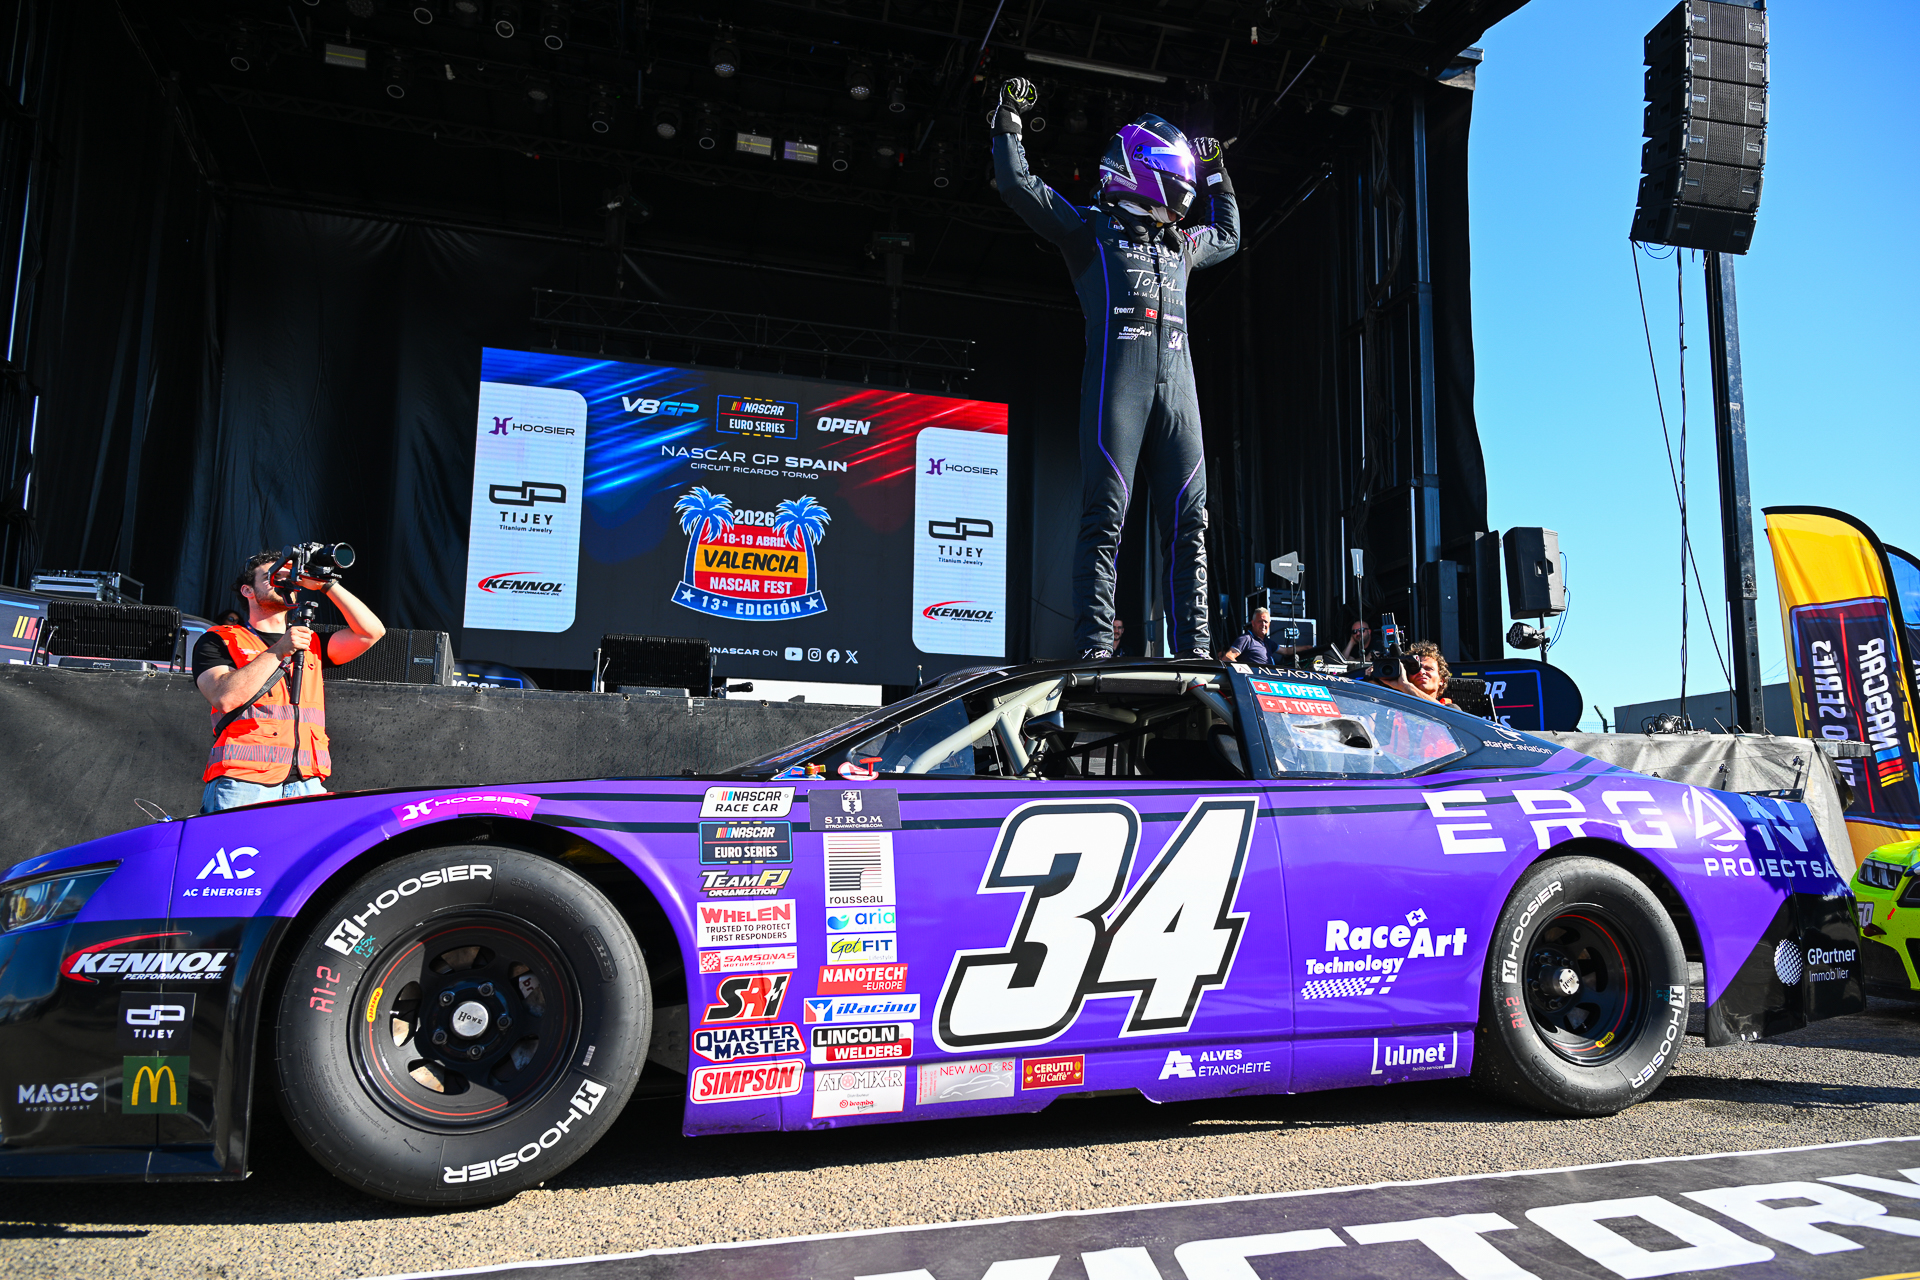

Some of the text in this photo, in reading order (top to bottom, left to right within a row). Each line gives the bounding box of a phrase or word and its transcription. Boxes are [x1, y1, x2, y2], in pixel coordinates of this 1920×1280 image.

[1168, 331, 1182, 350] 34
[622, 397, 699, 416] V8GP
[744, 402, 784, 416] NASCAR
[512, 423, 575, 436] HOOSIER
[729, 419, 785, 434] EURO SERIES
[817, 417, 870, 435] OPEN
[662, 445, 847, 472] NASCAR GP SPAIN
[691, 463, 819, 480] CIRCUIT RICARDO TORMO
[945, 464, 998, 475] HOOSIER
[500, 511, 553, 525] TIJEY
[735, 509, 775, 527] 2026
[499, 524, 552, 534] Titanium Jewelry
[722, 533, 786, 547] 18-19 ABRIL
[938, 545, 983, 558] TIJEY
[704, 549, 799, 573] VALENCIA
[483, 579, 563, 593] KENNOL
[709, 577, 792, 595] NASCAR FEST
[736, 600, 801, 616] EDICIÓN
[928, 607, 994, 620] KENNOL
[762, 649, 778, 657] ON
[1272, 682, 1330, 699] T. TOFFEL
[1280, 700, 1338, 716] T. TOFFEL
[1484, 740, 1552, 755] starjet aviation
[435, 795, 530, 808] HOOSIER
[733, 791, 782, 801] NASCAR
[715, 804, 778, 812] RACE CAR
[825, 816, 882, 825] STROM
[731, 827, 775, 839] NASCAR
[714, 845, 778, 858] EURO SERIES
[182, 886, 262, 897] AC ÉNERGIES
[352, 864, 494, 927] HOOSIER
[709, 887, 777, 897] ORGANIZATION
[829, 894, 884, 904] rousseau
[855, 908, 895, 925] aria
[1507, 880, 1563, 960] HOOSIER
[706, 923, 791, 933] TRUSTED TO PROTECT
[937, 799, 1257, 1050] 34
[711, 932, 787, 942] FIRST RESPONDERS
[70, 952, 228, 973] KENNOL
[724, 952, 796, 963] SAMSONAS
[1807, 948, 1856, 966] GPartner
[1305, 955, 1404, 975] Technology
[123, 971, 222, 980] PERFORMANCE OIL
[823, 967, 904, 983] NANOTECH
[836, 1001, 917, 1015] iRacing
[133, 1029, 174, 1039] TIJEY
[696, 1024, 795, 1051] QUARTER
[817, 1027, 895, 1045] LINCOLN
[715, 1038, 800, 1061] MASTER
[834, 1044, 902, 1060] WELDERS
[1200, 1049, 1242, 1062] ALVES
[1629, 1008, 1682, 1089] HOOSIER
[940, 1064, 967, 1076] NEW
[1034, 1062, 1073, 1073] CERUTTI
[1198, 1061, 1271, 1077] ÉTANCHÉITÉ
[700, 1066, 796, 1096] SIMPSON
[25, 1104, 91, 1112] MOTORSPORT
[443, 1106, 582, 1186] HOOSIER
